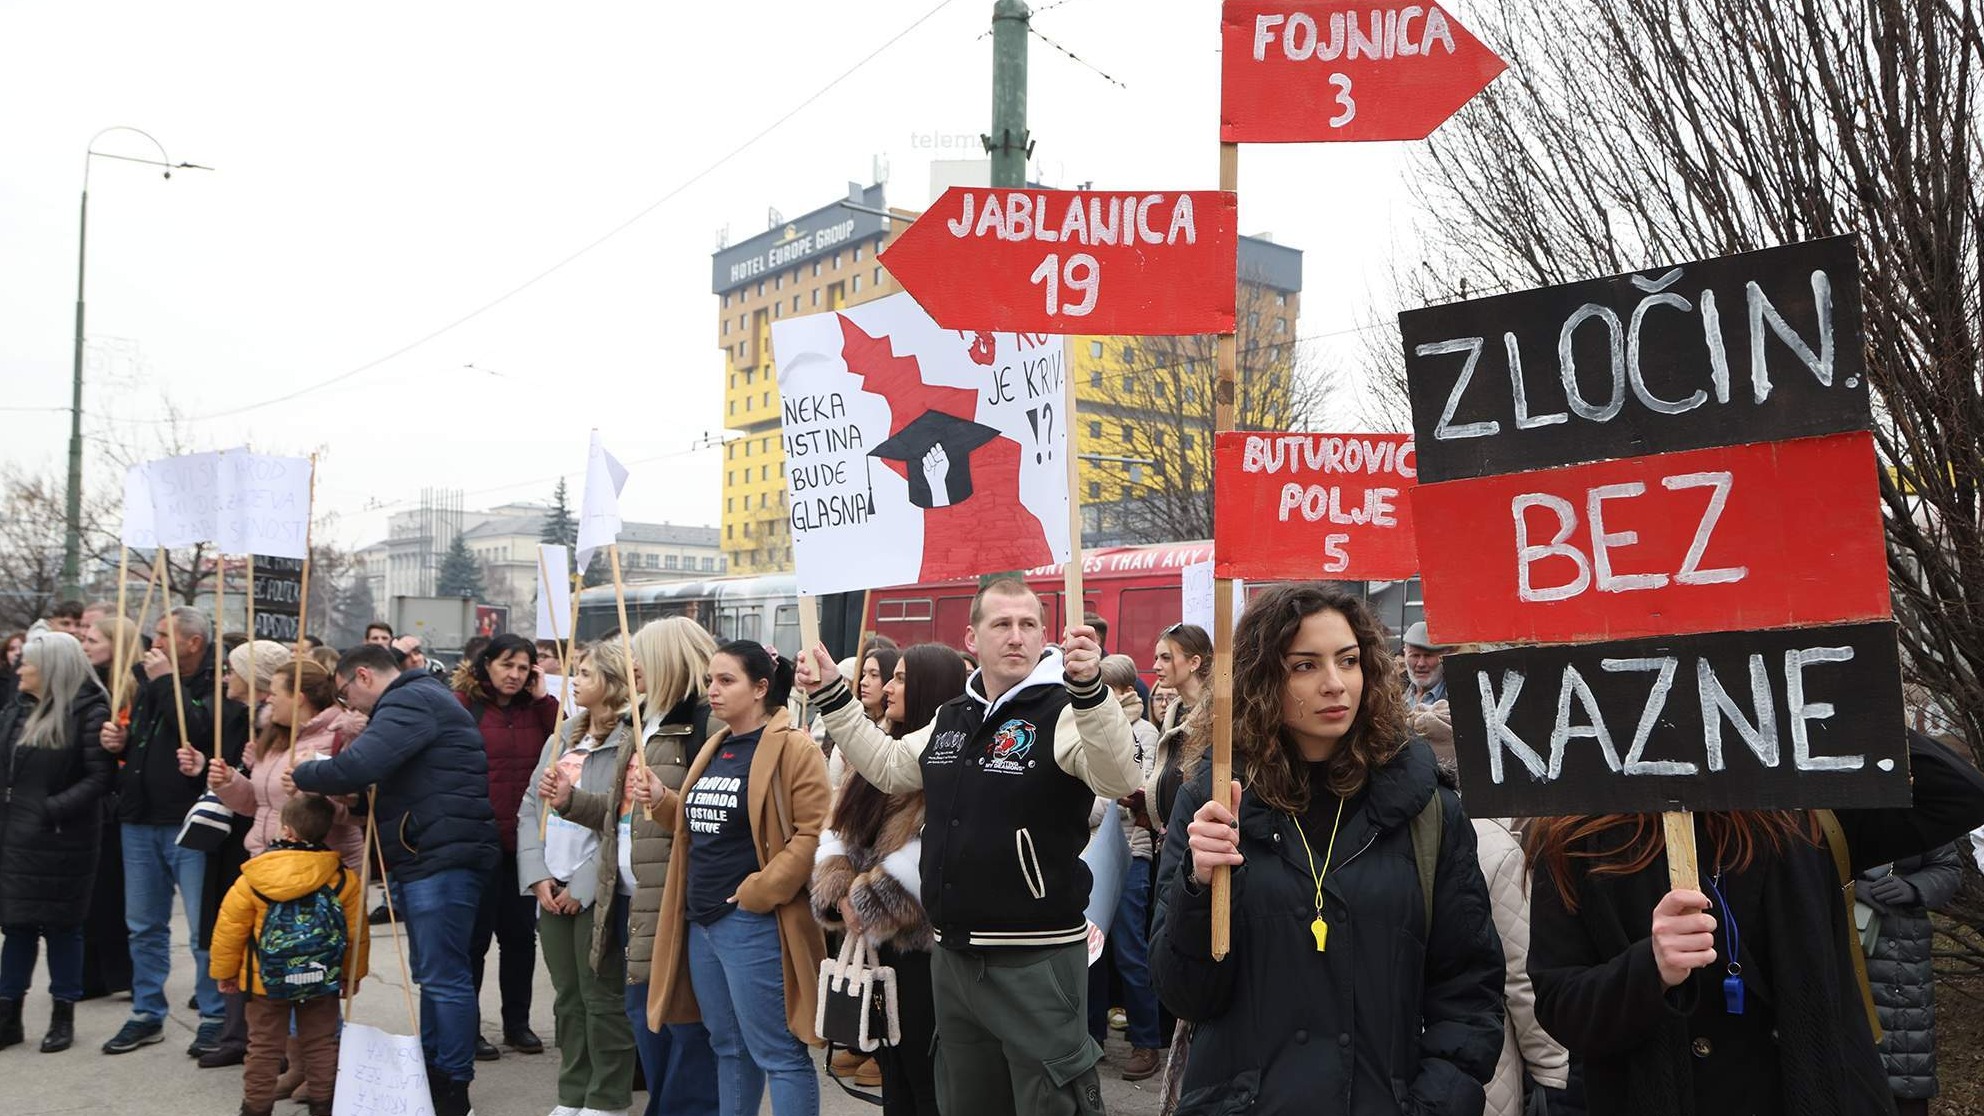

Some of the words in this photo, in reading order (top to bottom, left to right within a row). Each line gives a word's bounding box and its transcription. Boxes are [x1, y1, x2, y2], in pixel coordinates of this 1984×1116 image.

[1252, 5, 1456, 62] FOJNICA
[1328, 72, 1356, 128] 3
[910, 130, 984, 149] telem
[946, 192, 1197, 247] JABLANICA
[730, 255, 766, 283] HOTEL
[768, 235, 813, 268] EUROPE
[815, 219, 855, 250] GROUP
[1030, 253, 1100, 317] 19
[1415, 267, 1861, 441] ZLOČIN.
[988, 366, 1016, 406] JE
[783, 392, 846, 426] NEKA
[787, 424, 863, 458] ISTINA
[791, 460, 848, 492] BUDE
[791, 493, 868, 532] GLASNA
[1278, 482, 1400, 528] POLJE
[1322, 533, 1350, 573] 5
[1512, 470, 1750, 602] BEZ
[1110, 550, 1155, 571] THAN
[1161, 549, 1204, 568] ANY
[1477, 645, 1895, 784] KAZNE.
[690, 807, 728, 822] OSTALE
